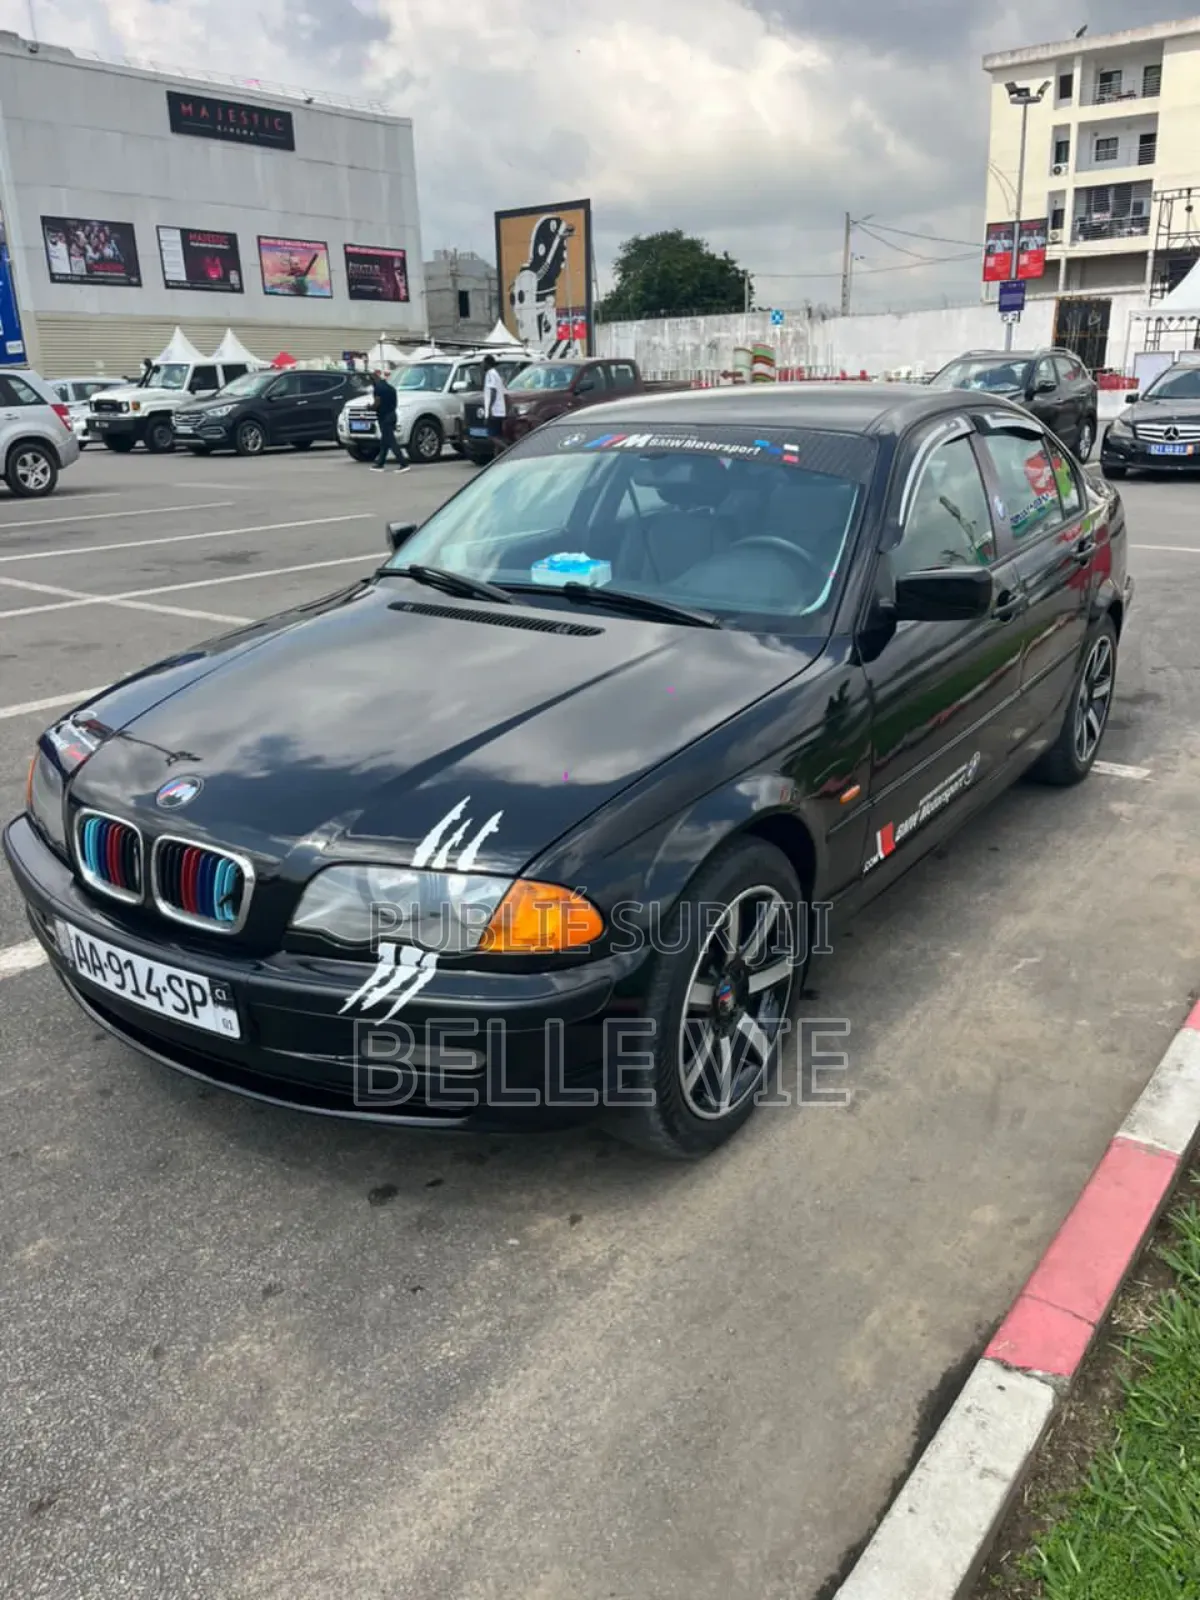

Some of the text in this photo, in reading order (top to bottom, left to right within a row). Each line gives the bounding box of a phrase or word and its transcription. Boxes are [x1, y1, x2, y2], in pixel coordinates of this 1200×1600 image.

[180, 103, 285, 131] MAJESTIC
[649, 438, 685, 448] BMW
[682, 439, 761, 456] Motorsport
